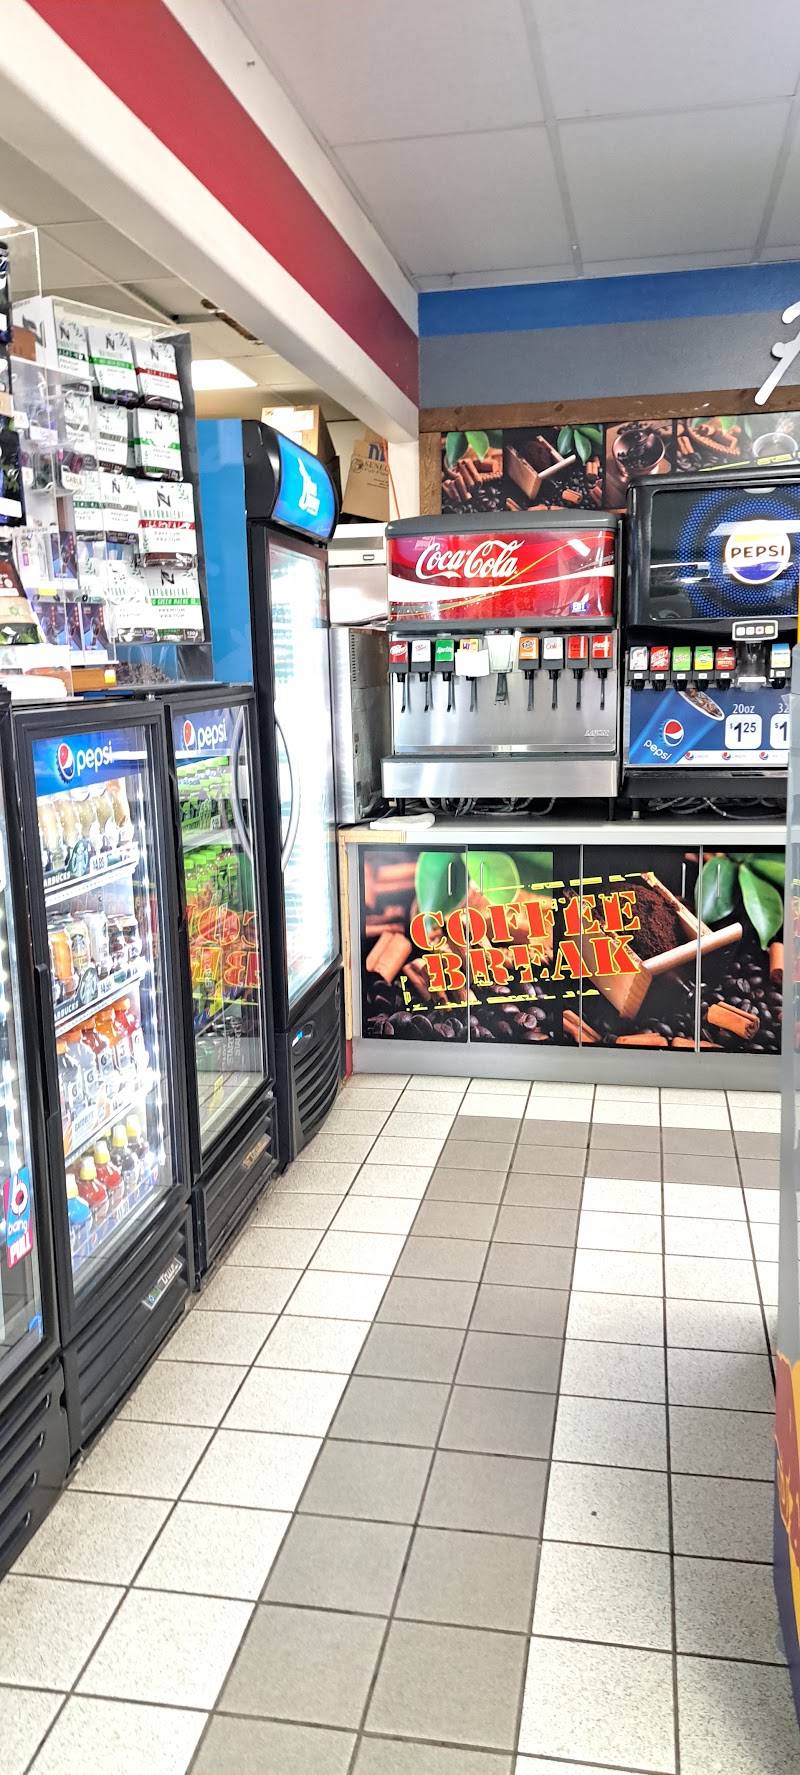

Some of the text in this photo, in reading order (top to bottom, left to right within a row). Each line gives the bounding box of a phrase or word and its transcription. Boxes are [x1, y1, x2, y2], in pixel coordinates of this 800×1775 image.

[415, 540, 526, 580] Coca-Cola
[731, 545, 785, 559] PEPSI
[732, 703, 756, 715] 20oz
[197, 719, 228, 751] pepsi
[643, 739, 673, 761] pepsi
[76, 740, 114, 777] pepsi
[410, 890, 642, 952] COFFEE
[422, 935, 642, 993] BREAK
[10, 1231, 31, 1265] PULL
